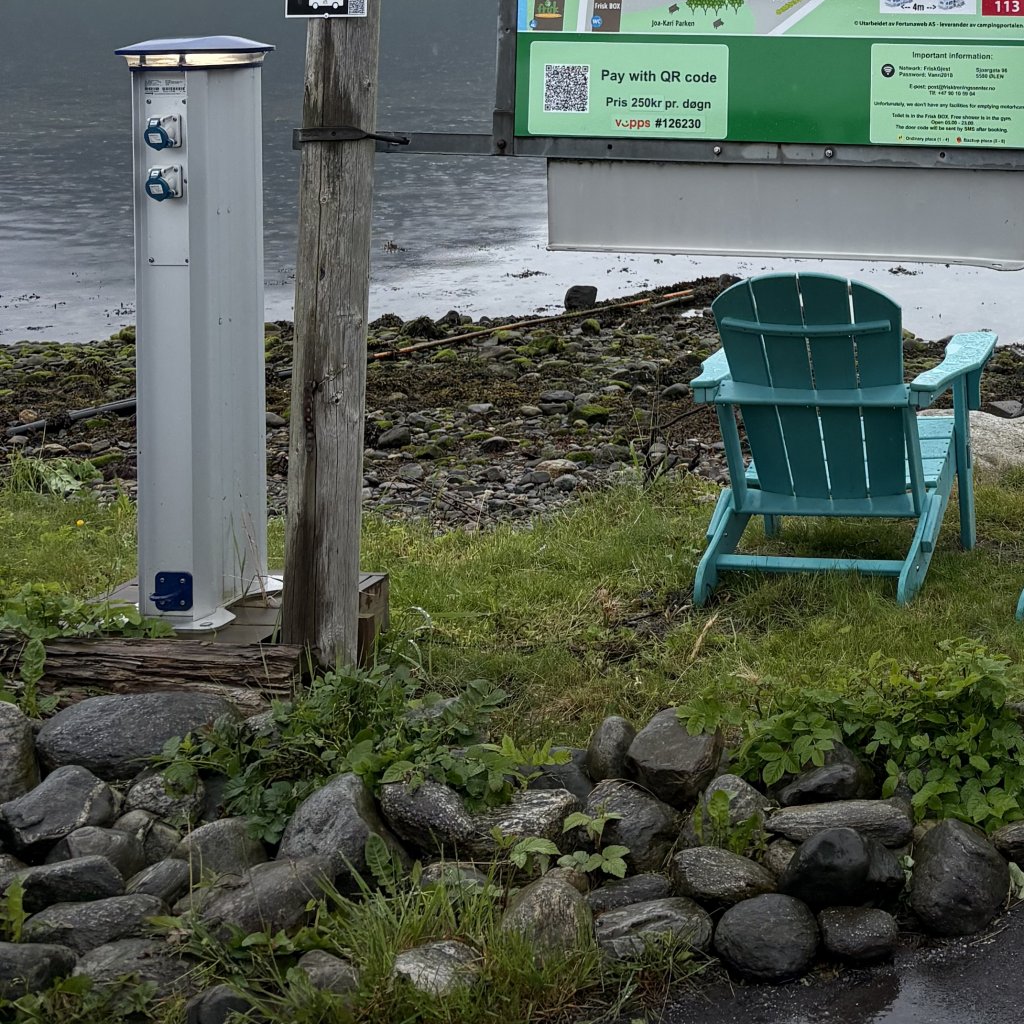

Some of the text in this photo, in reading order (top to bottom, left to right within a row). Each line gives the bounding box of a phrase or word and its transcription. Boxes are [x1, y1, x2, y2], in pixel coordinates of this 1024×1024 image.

[994, 0, 1020, 13] 113
[912, 51, 994, 60] Important information:
[601, 69, 717, 84] Pay with QR code
[606, 97, 711, 111] Pris 250kr pr. døgn
[655, 118, 701, 129] #126230
